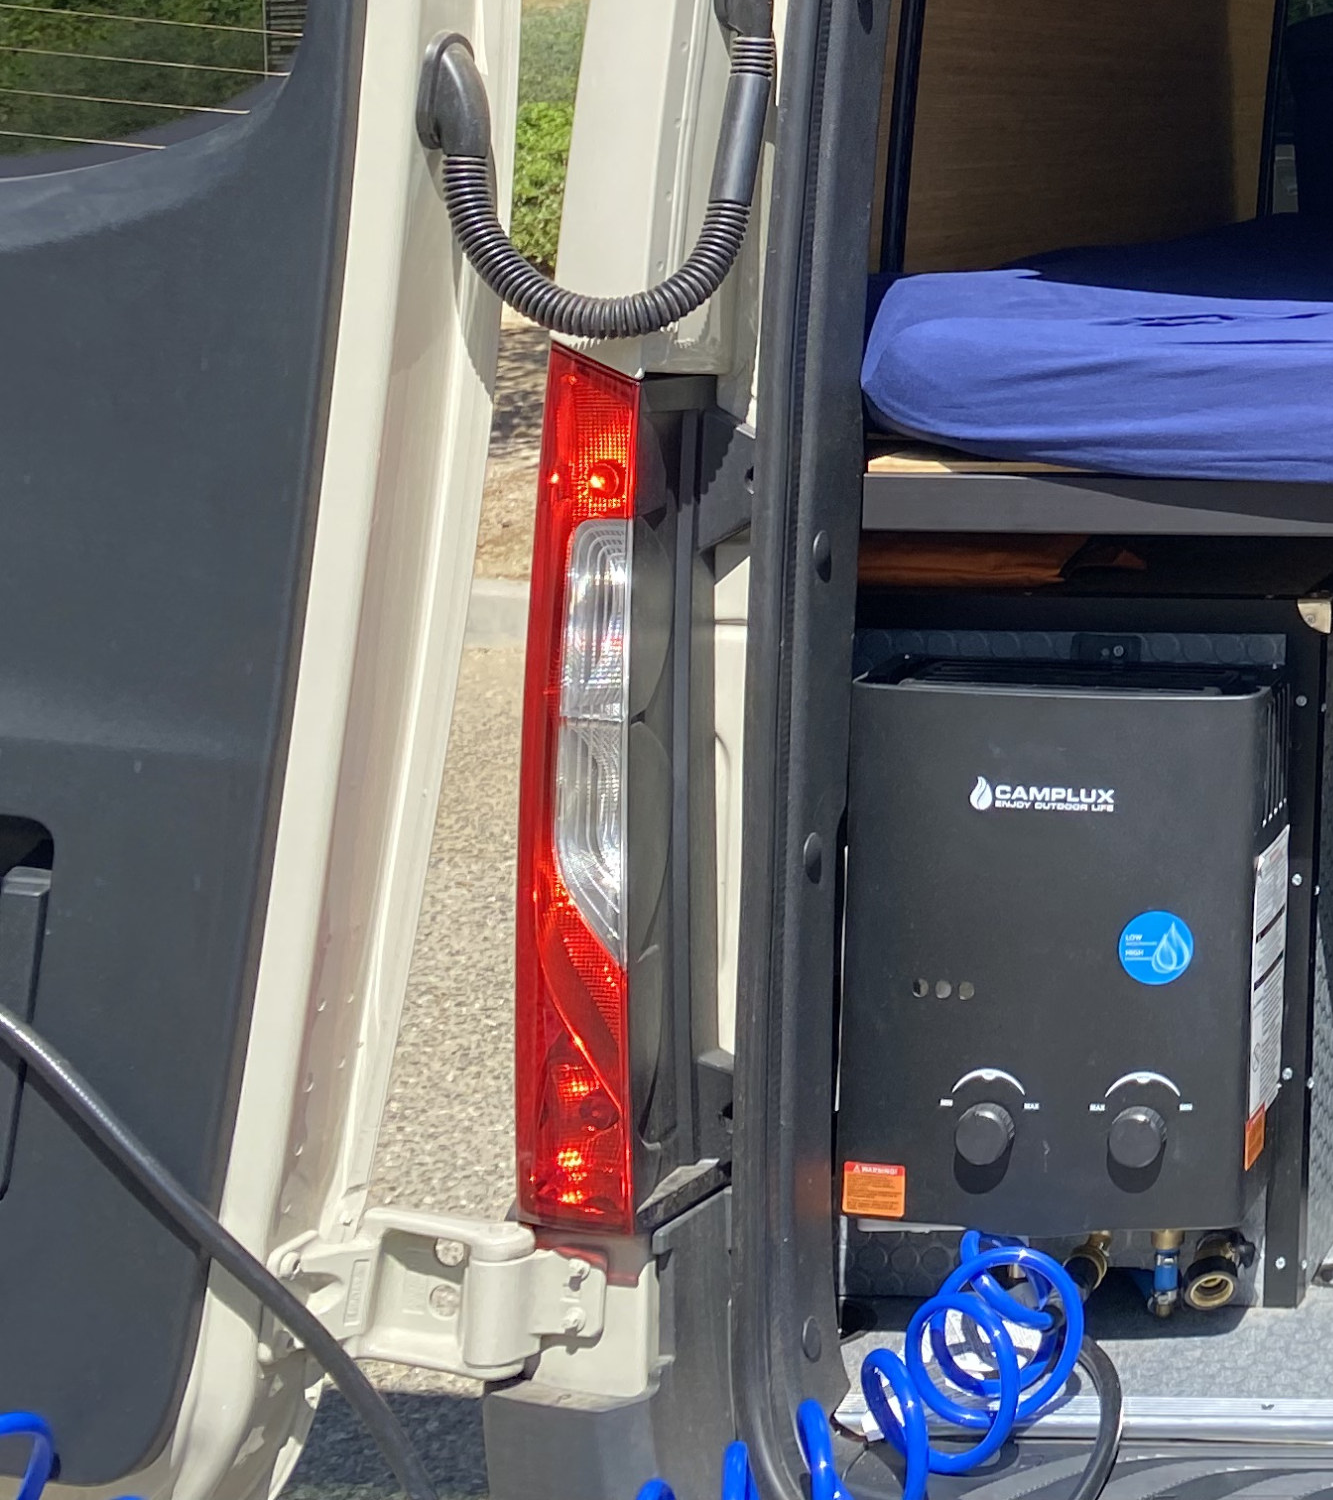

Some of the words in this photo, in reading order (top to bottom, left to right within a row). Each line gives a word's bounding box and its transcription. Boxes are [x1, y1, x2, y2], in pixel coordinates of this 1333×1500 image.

[994, 784, 1115, 804] CAMPLUX
[994, 800, 1031, 810] ENJOY
[1034, 801, 1088, 812] OUTDOOR
[1091, 803, 1114, 812] LIFE
[1125, 933, 1143, 942] LOW
[1125, 948, 1144, 957] HIGH
